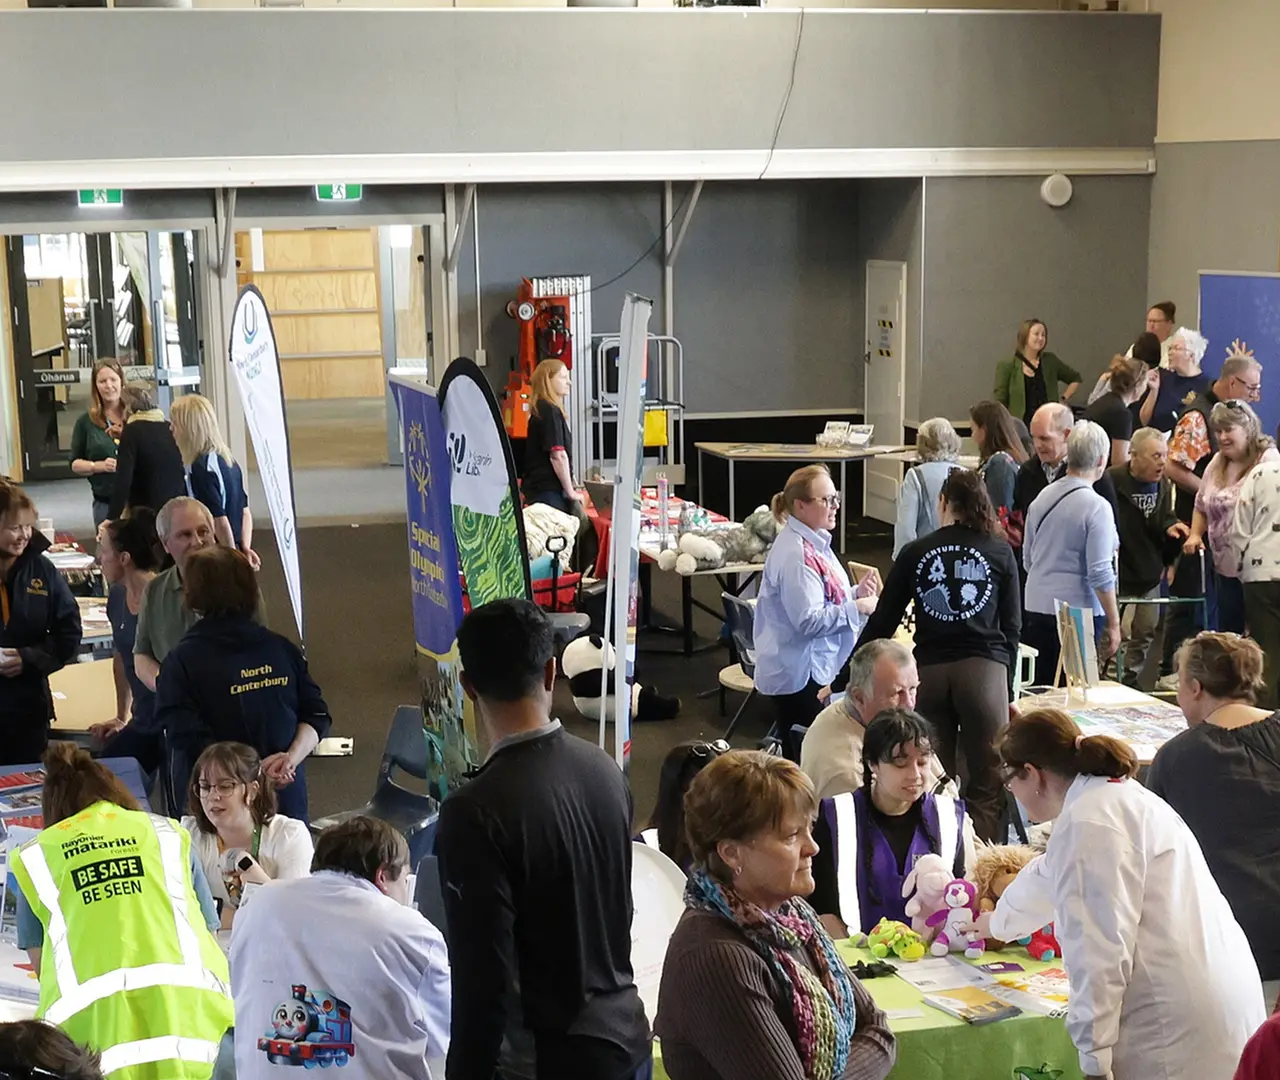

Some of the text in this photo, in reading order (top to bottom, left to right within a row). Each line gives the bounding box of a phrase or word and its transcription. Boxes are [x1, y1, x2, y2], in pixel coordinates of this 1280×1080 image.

[916, 545, 991, 575] ADVENTURE SOCIAL
[960, 583, 993, 620] EDUCATION
[240, 664, 272, 678] North
[230, 676, 289, 695] Canterbury
[63, 836, 137, 860] matariki
[77, 858, 139, 887] BE SAFE
[82, 880, 142, 905] BE SEEN
